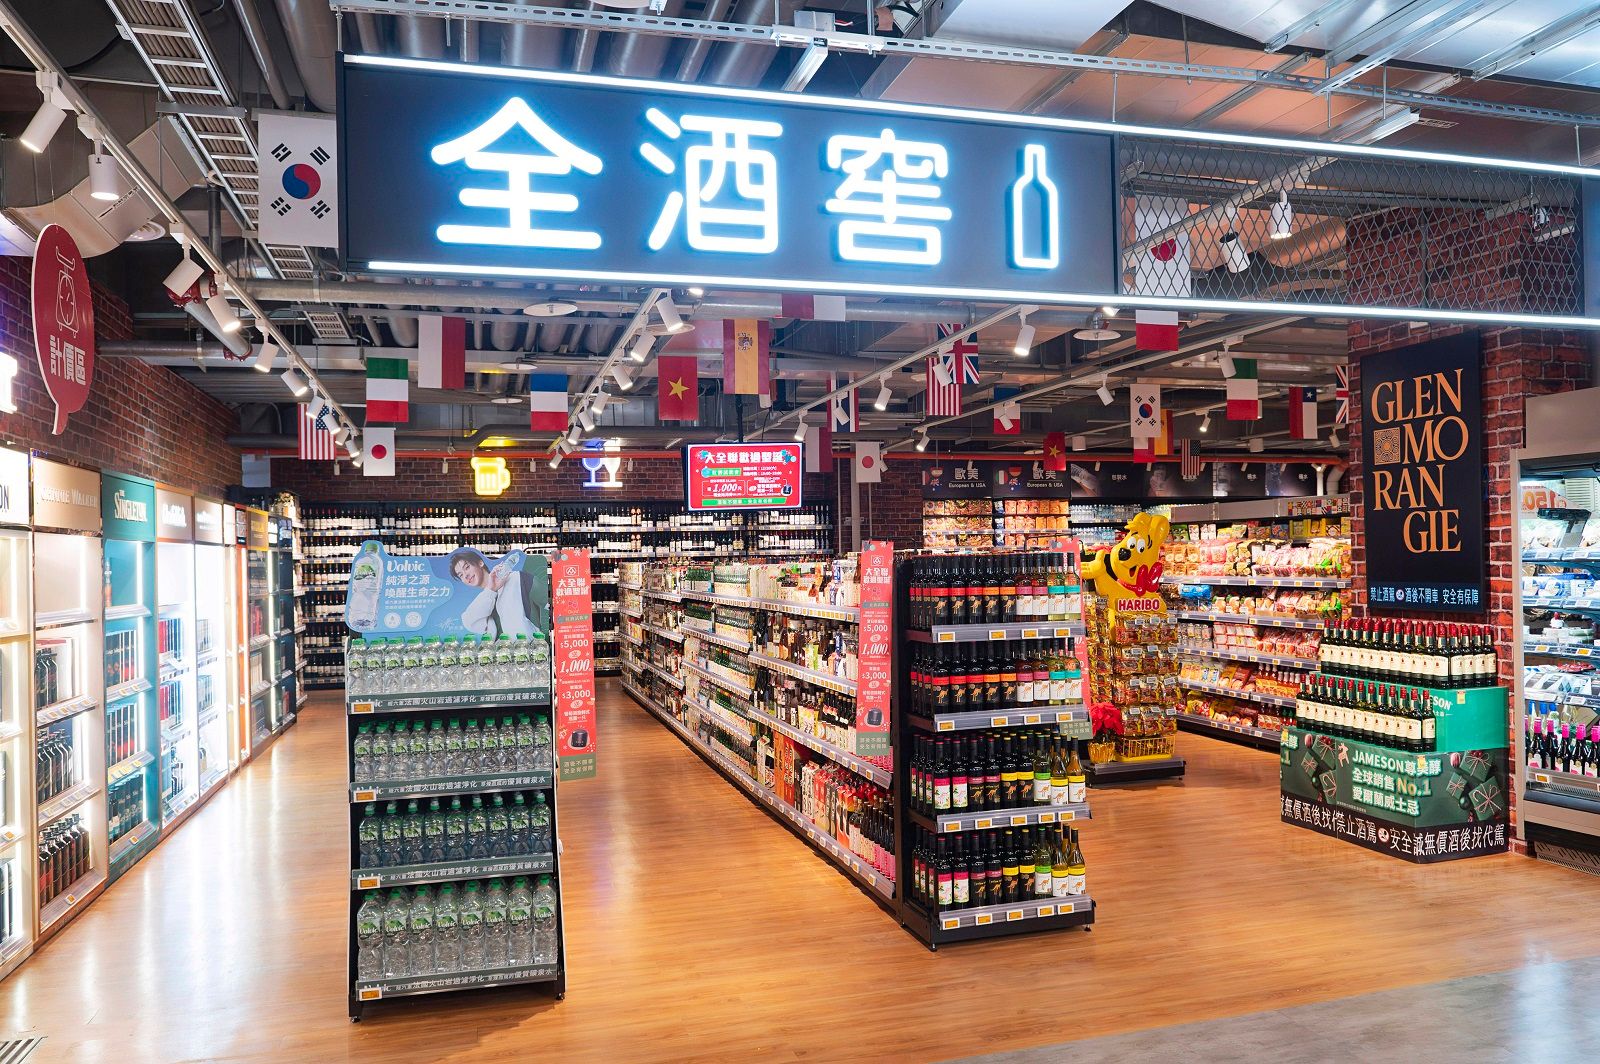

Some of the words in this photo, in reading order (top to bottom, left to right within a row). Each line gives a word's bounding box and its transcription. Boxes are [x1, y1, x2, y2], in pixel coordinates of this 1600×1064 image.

[429, 94, 954, 267] 全酒窖
[49, 334, 86, 386] 計價區
[1371, 368, 1464, 424] GLEN
[1403, 415, 1469, 464] MO
[954, 467, 979, 480] 歐美
[1372, 464, 1446, 511] RAN
[1402, 509, 1462, 554] GIE
[386, 560, 425, 573] Volvic
[865, 567, 889, 577] 大全聯
[385, 574, 430, 586] 純淨之源
[557, 577, 587, 589] 大全聯
[384, 586, 451, 599] 喚醒生命之力
[1370, 586, 1395, 602] 禁止酒駕
[1404, 587, 1439, 604] 酒後不開車
[1442, 588, 1479, 605] 安全有保障
[1118, 598, 1161, 612] HARIBO
[863, 624, 888, 633] $5,000
[560, 639, 589, 650] $5,000
[861, 671, 887, 680] $3,000
[562, 688, 591, 699] $3,000
[1352, 769, 1395, 789] 全球銷售
[1397, 777, 1432, 796] No.1
[1352, 786, 1421, 817] 愛爾蘭威士忌
[1337, 810, 1377, 844] 禁止酒駕
